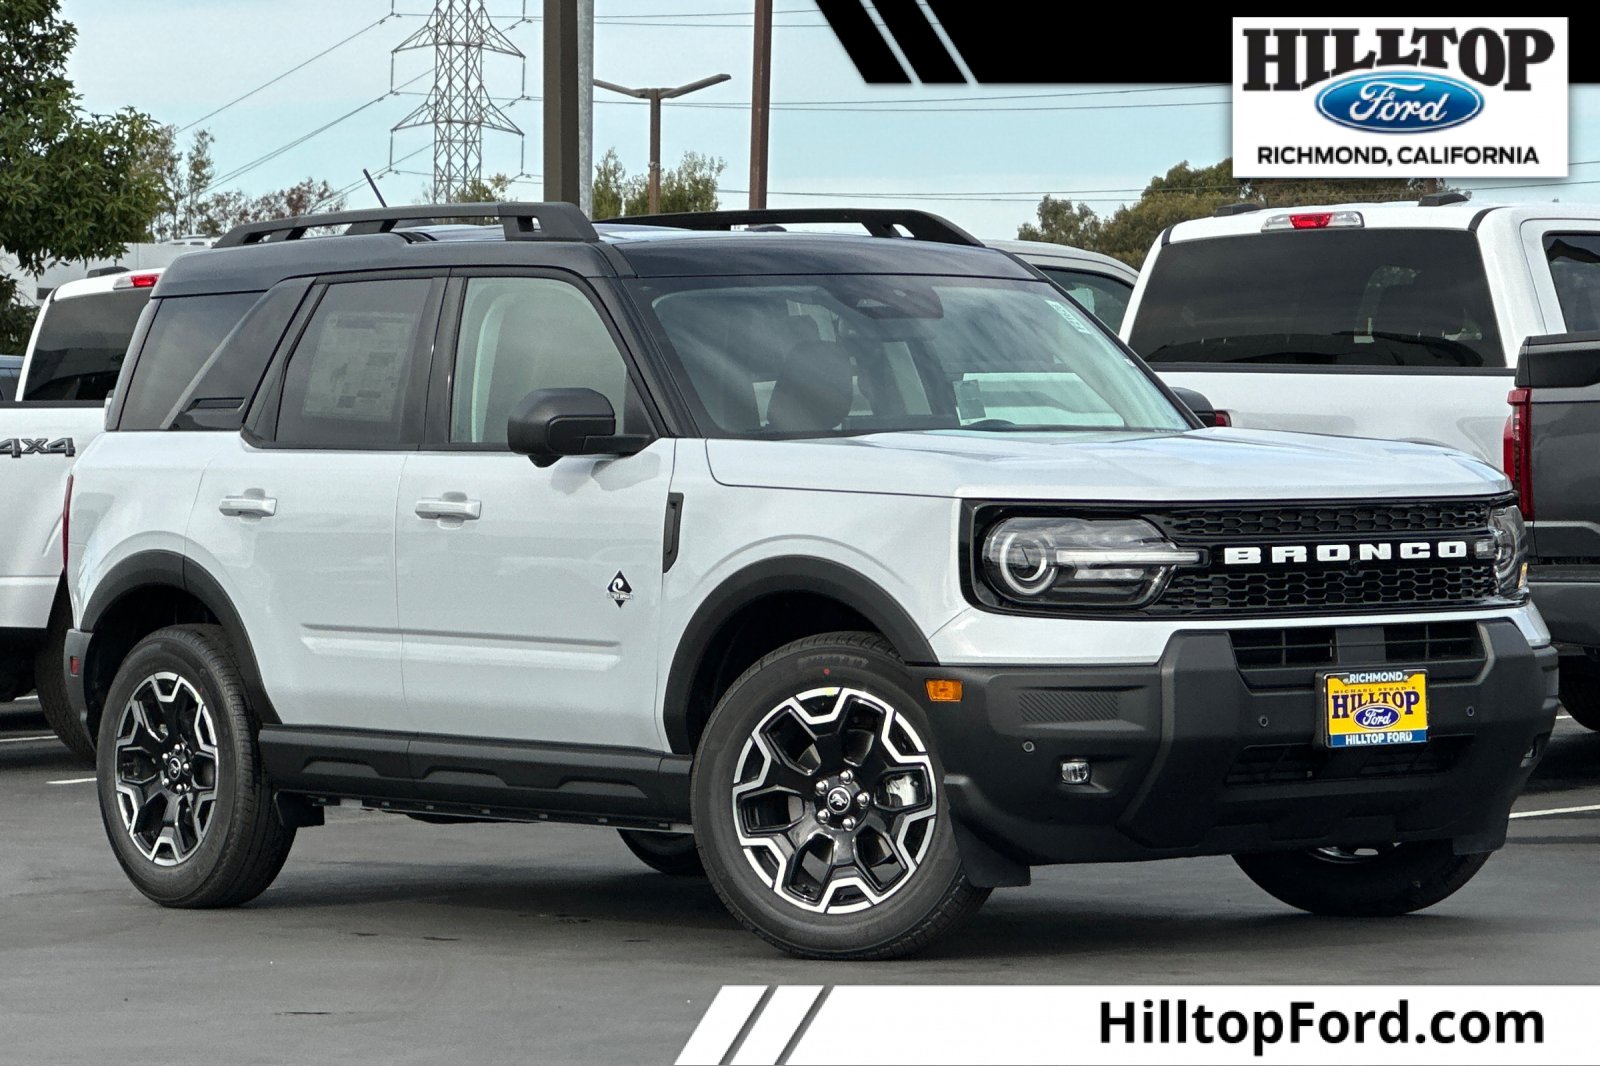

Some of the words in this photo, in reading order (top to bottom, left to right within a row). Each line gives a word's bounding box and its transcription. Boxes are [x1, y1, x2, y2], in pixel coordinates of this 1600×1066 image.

[1223, 540, 1467, 565] BRONCO
[1349, 671, 1403, 683] RICHMOND
[1331, 690, 1420, 719] HILLTOP
[1362, 708, 1392, 726] Ford
[1345, 733, 1385, 745] HILLTOP
[1387, 732, 1413, 743] FORD
